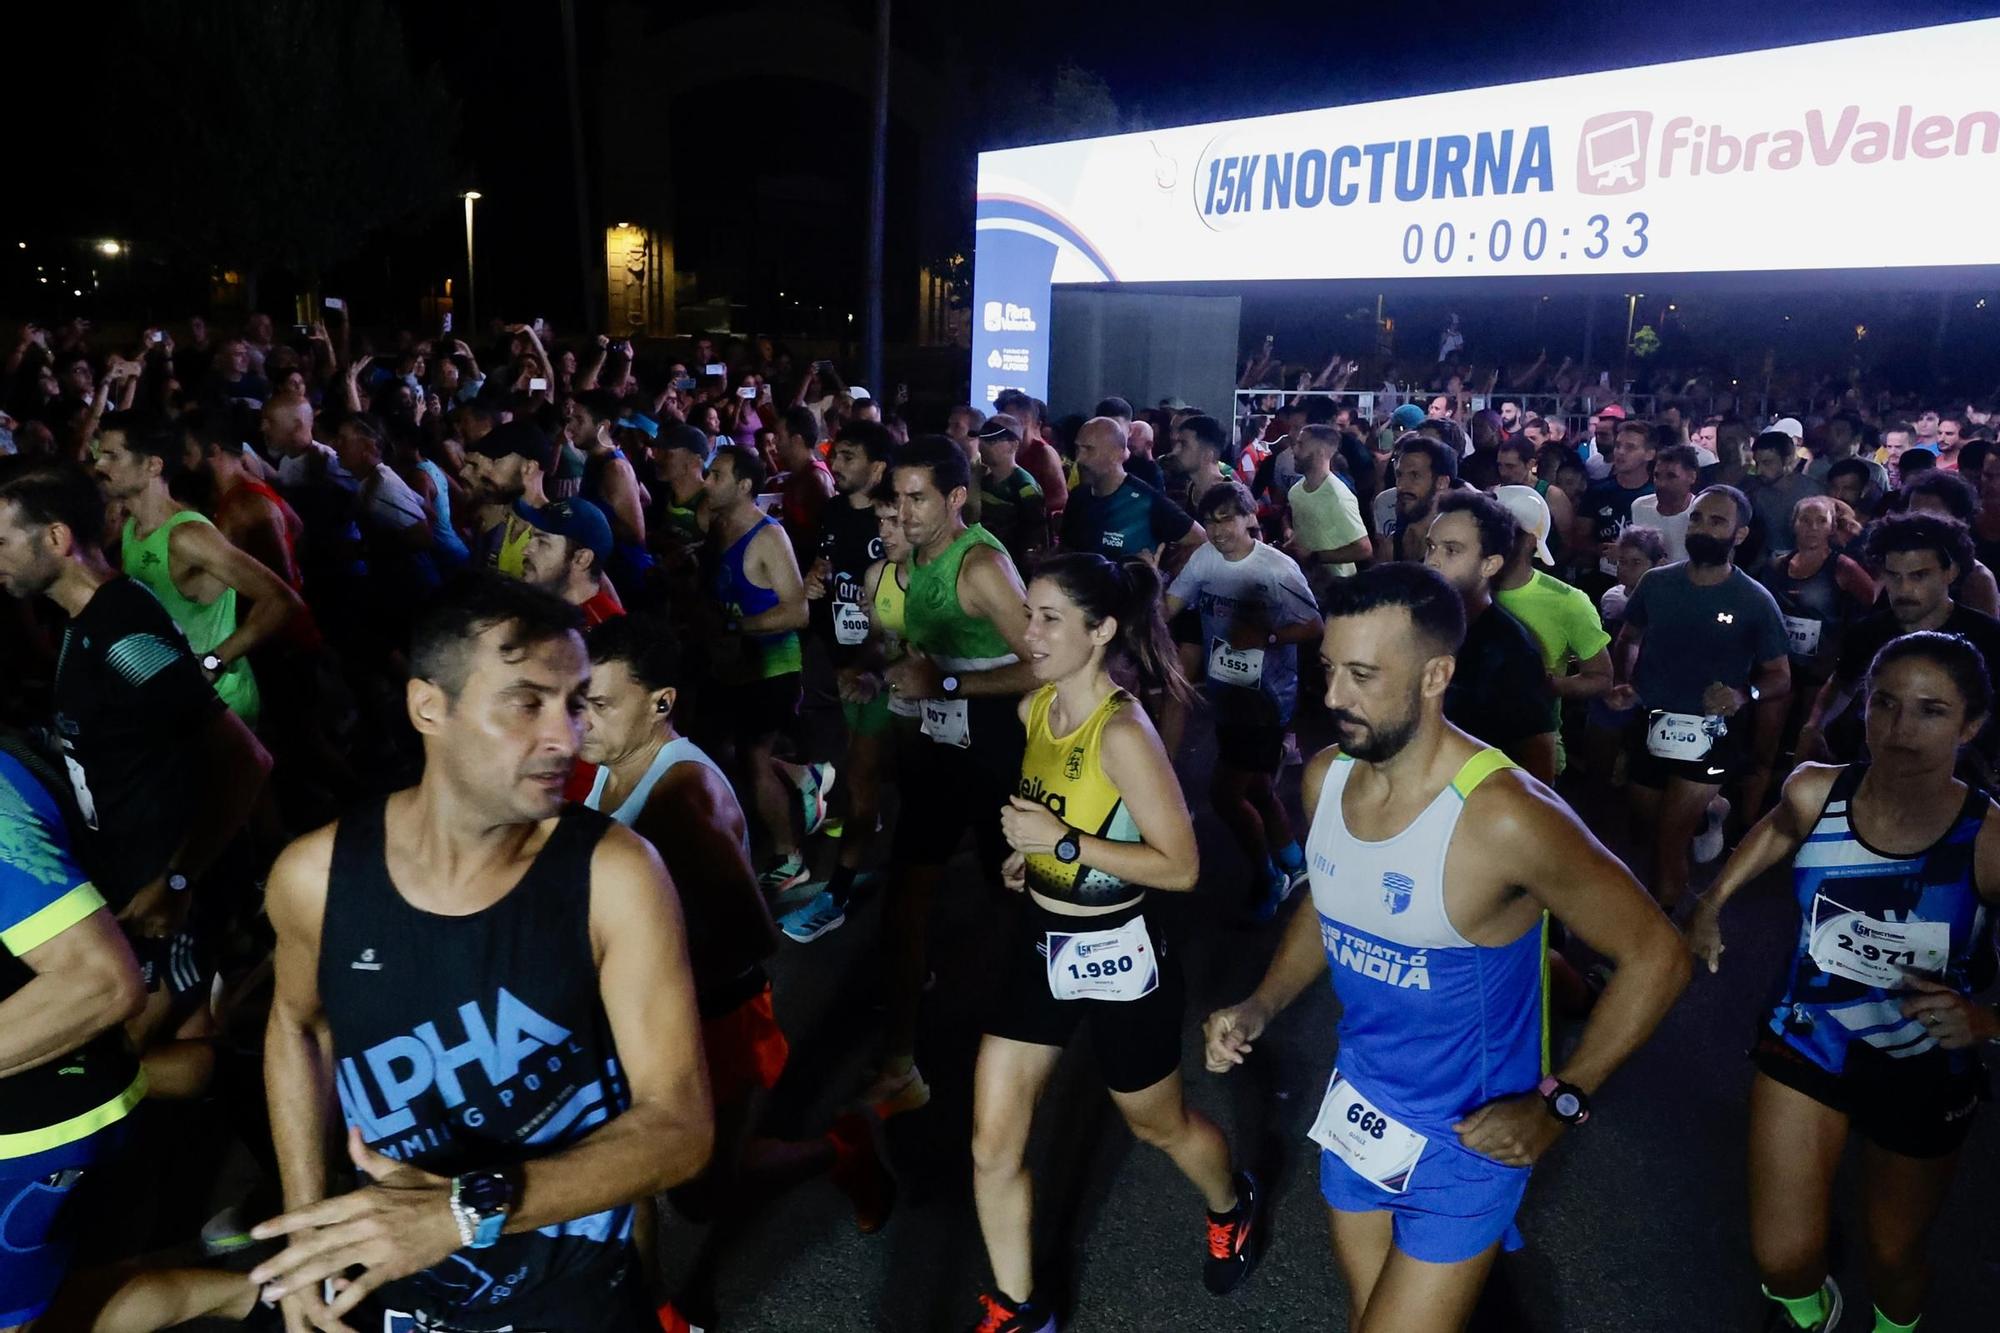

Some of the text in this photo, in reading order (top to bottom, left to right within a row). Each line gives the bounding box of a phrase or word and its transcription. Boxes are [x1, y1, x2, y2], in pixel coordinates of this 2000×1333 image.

[1204, 125, 1554, 215] 15K NOCTURNA
[1403, 212, 1650, 264] 00:00:33
[1219, 656, 1249, 673] 1.552
[1018, 777, 1067, 818] eika
[1068, 955, 1133, 980] 1.980
[1343, 933, 1428, 967] TRIATLÓ
[1838, 934, 1915, 965] 2.971
[1346, 1102, 1387, 1140] 668
